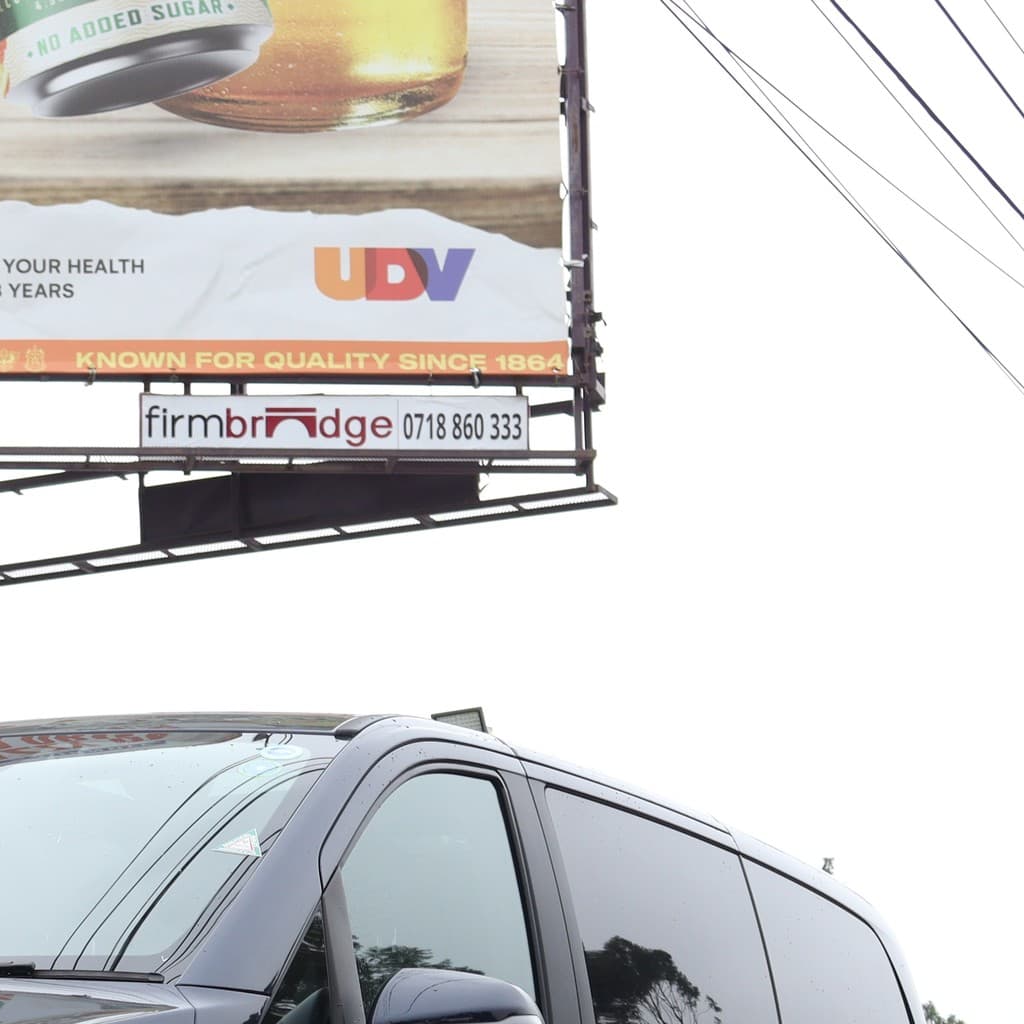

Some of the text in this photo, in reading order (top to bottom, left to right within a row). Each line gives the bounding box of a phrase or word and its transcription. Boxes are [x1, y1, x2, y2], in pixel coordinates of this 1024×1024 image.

[37, 0, 223, 57] NO ADDED SUGAR
[2, 259, 62, 274] YOUR
[68, 259, 145, 275] HEALTH
[314, 247, 476, 301] UDV
[8, 283, 75, 299] YEARS
[76, 351, 187, 369] KNOWN
[195, 351, 256, 369] FOR
[263, 351, 391, 371] QUALITY
[398, 352, 487, 371] SINCE
[495, 352, 565, 372] 1864
[402, 412, 446, 441] 0718
[452, 412, 485, 441] 860
[489, 413, 522, 441] 333
